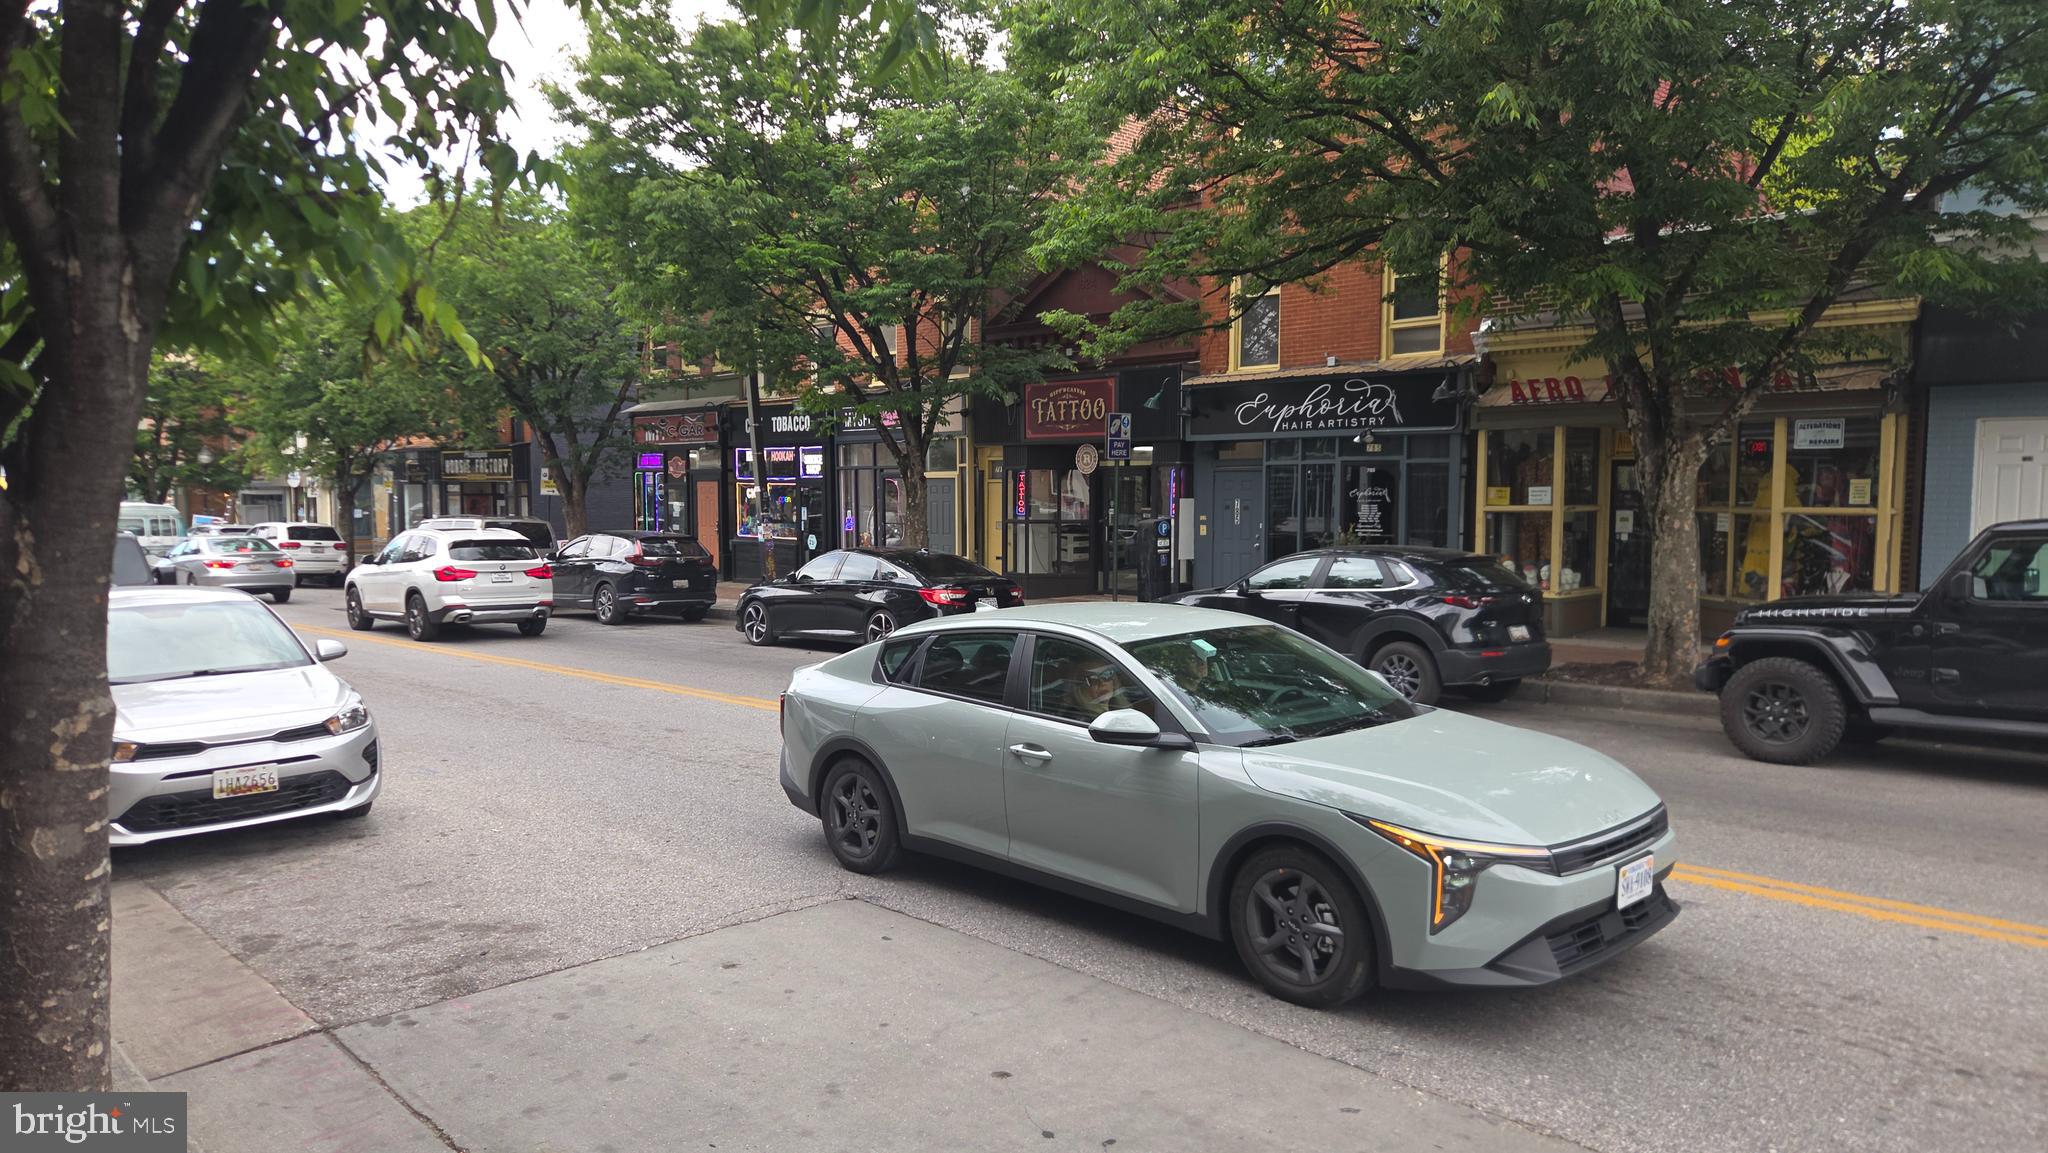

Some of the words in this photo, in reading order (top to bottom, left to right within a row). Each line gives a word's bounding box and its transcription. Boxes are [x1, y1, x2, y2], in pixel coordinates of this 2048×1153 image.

[1509, 375, 1586, 403] AFRO
[1031, 397, 1106, 424] TATTOO
[1234, 378, 1392, 432] Euphoria
[771, 415, 811, 433] TOBACCO
[1282, 421, 1313, 430] HAIR
[1317, 416, 1386, 429] ARTISTRY
[1799, 421, 1842, 430] ALTERATIONS
[1111, 449, 1128, 457] HERE
[1113, 441, 1125, 449] PAY
[475, 458, 509, 474] FACTORY
[1018, 474, 1026, 513] TATTOO
